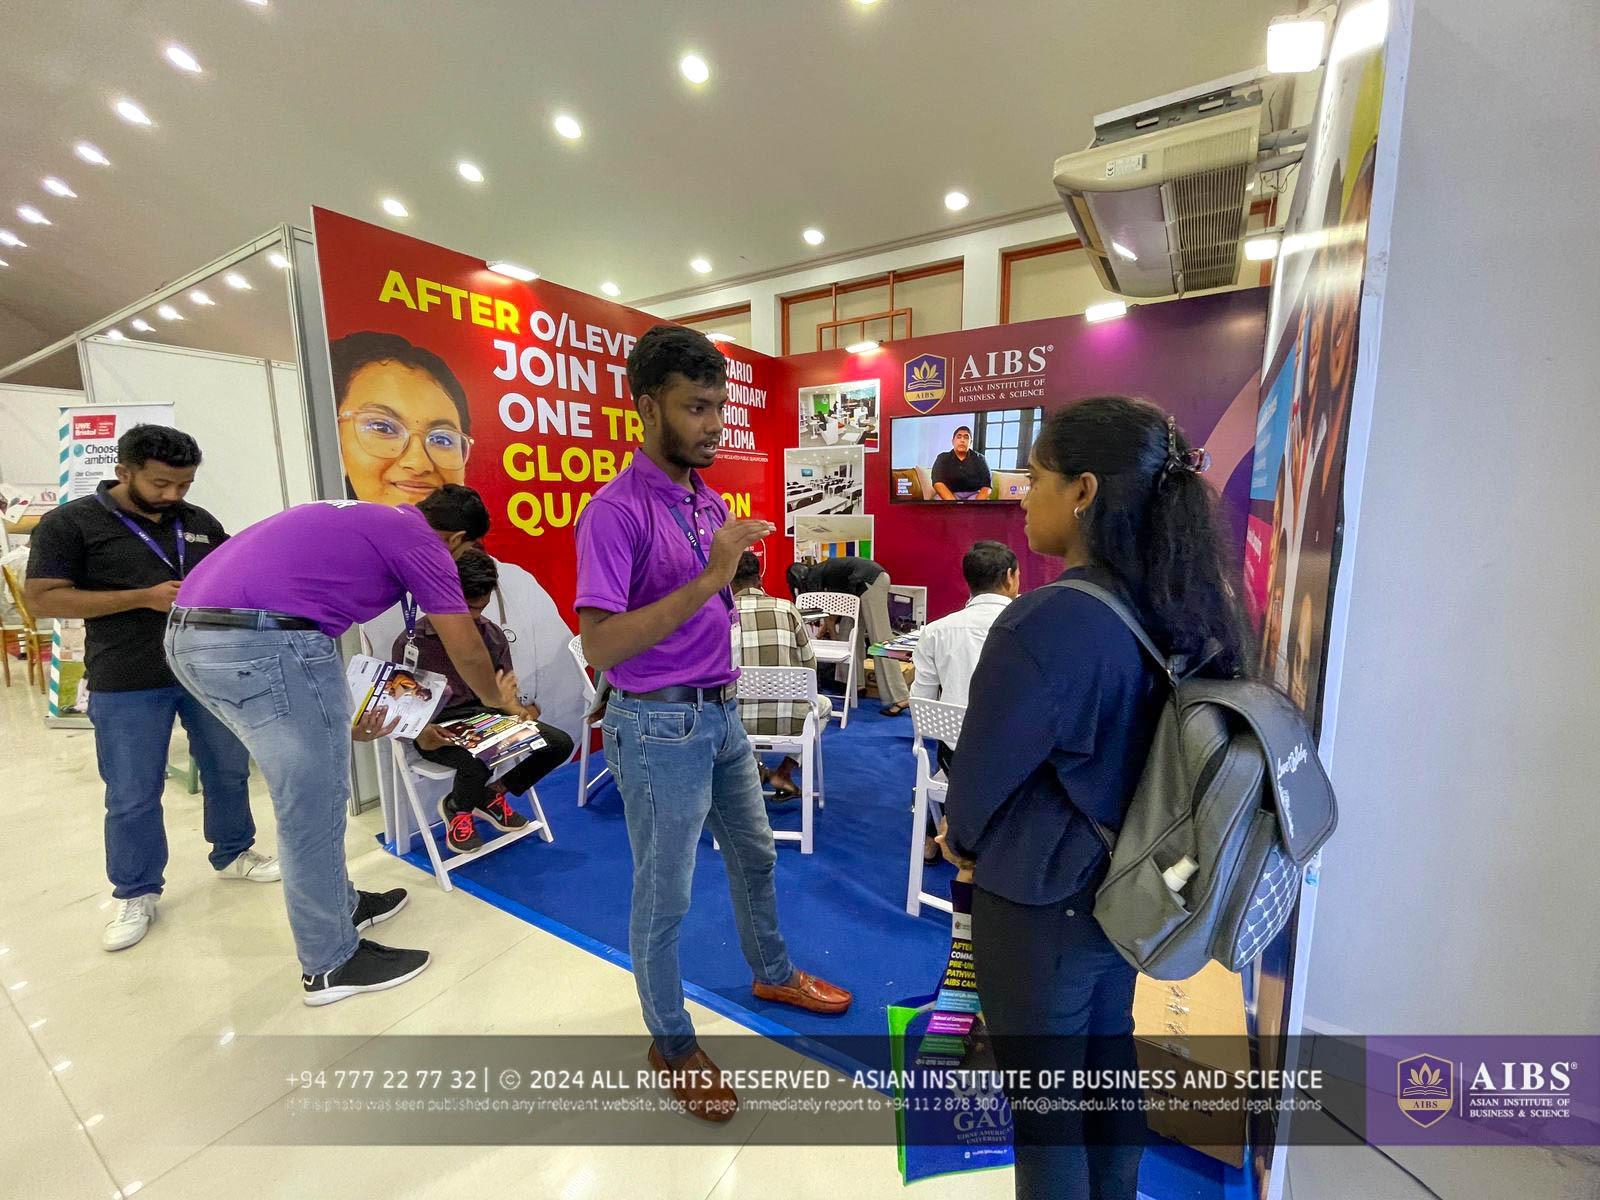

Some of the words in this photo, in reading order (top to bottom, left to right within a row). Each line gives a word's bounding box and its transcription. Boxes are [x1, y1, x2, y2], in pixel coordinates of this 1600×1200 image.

[378, 269, 521, 335] AFTER
[529, 310, 638, 360] O/LEVE
[493, 338, 597, 395] JOIN
[606, 363, 634, 401] T
[915, 391, 936, 400] AIBS
[959, 384, 984, 394] ASIAN
[987, 379, 1030, 391] INSTITUTE
[1033, 378, 1046, 387] OF
[959, 393, 996, 403] BUSINESS
[1009, 388, 1045, 399] SCIENCE
[498, 392, 593, 438] ONE
[721, 404, 751, 428] HOOL
